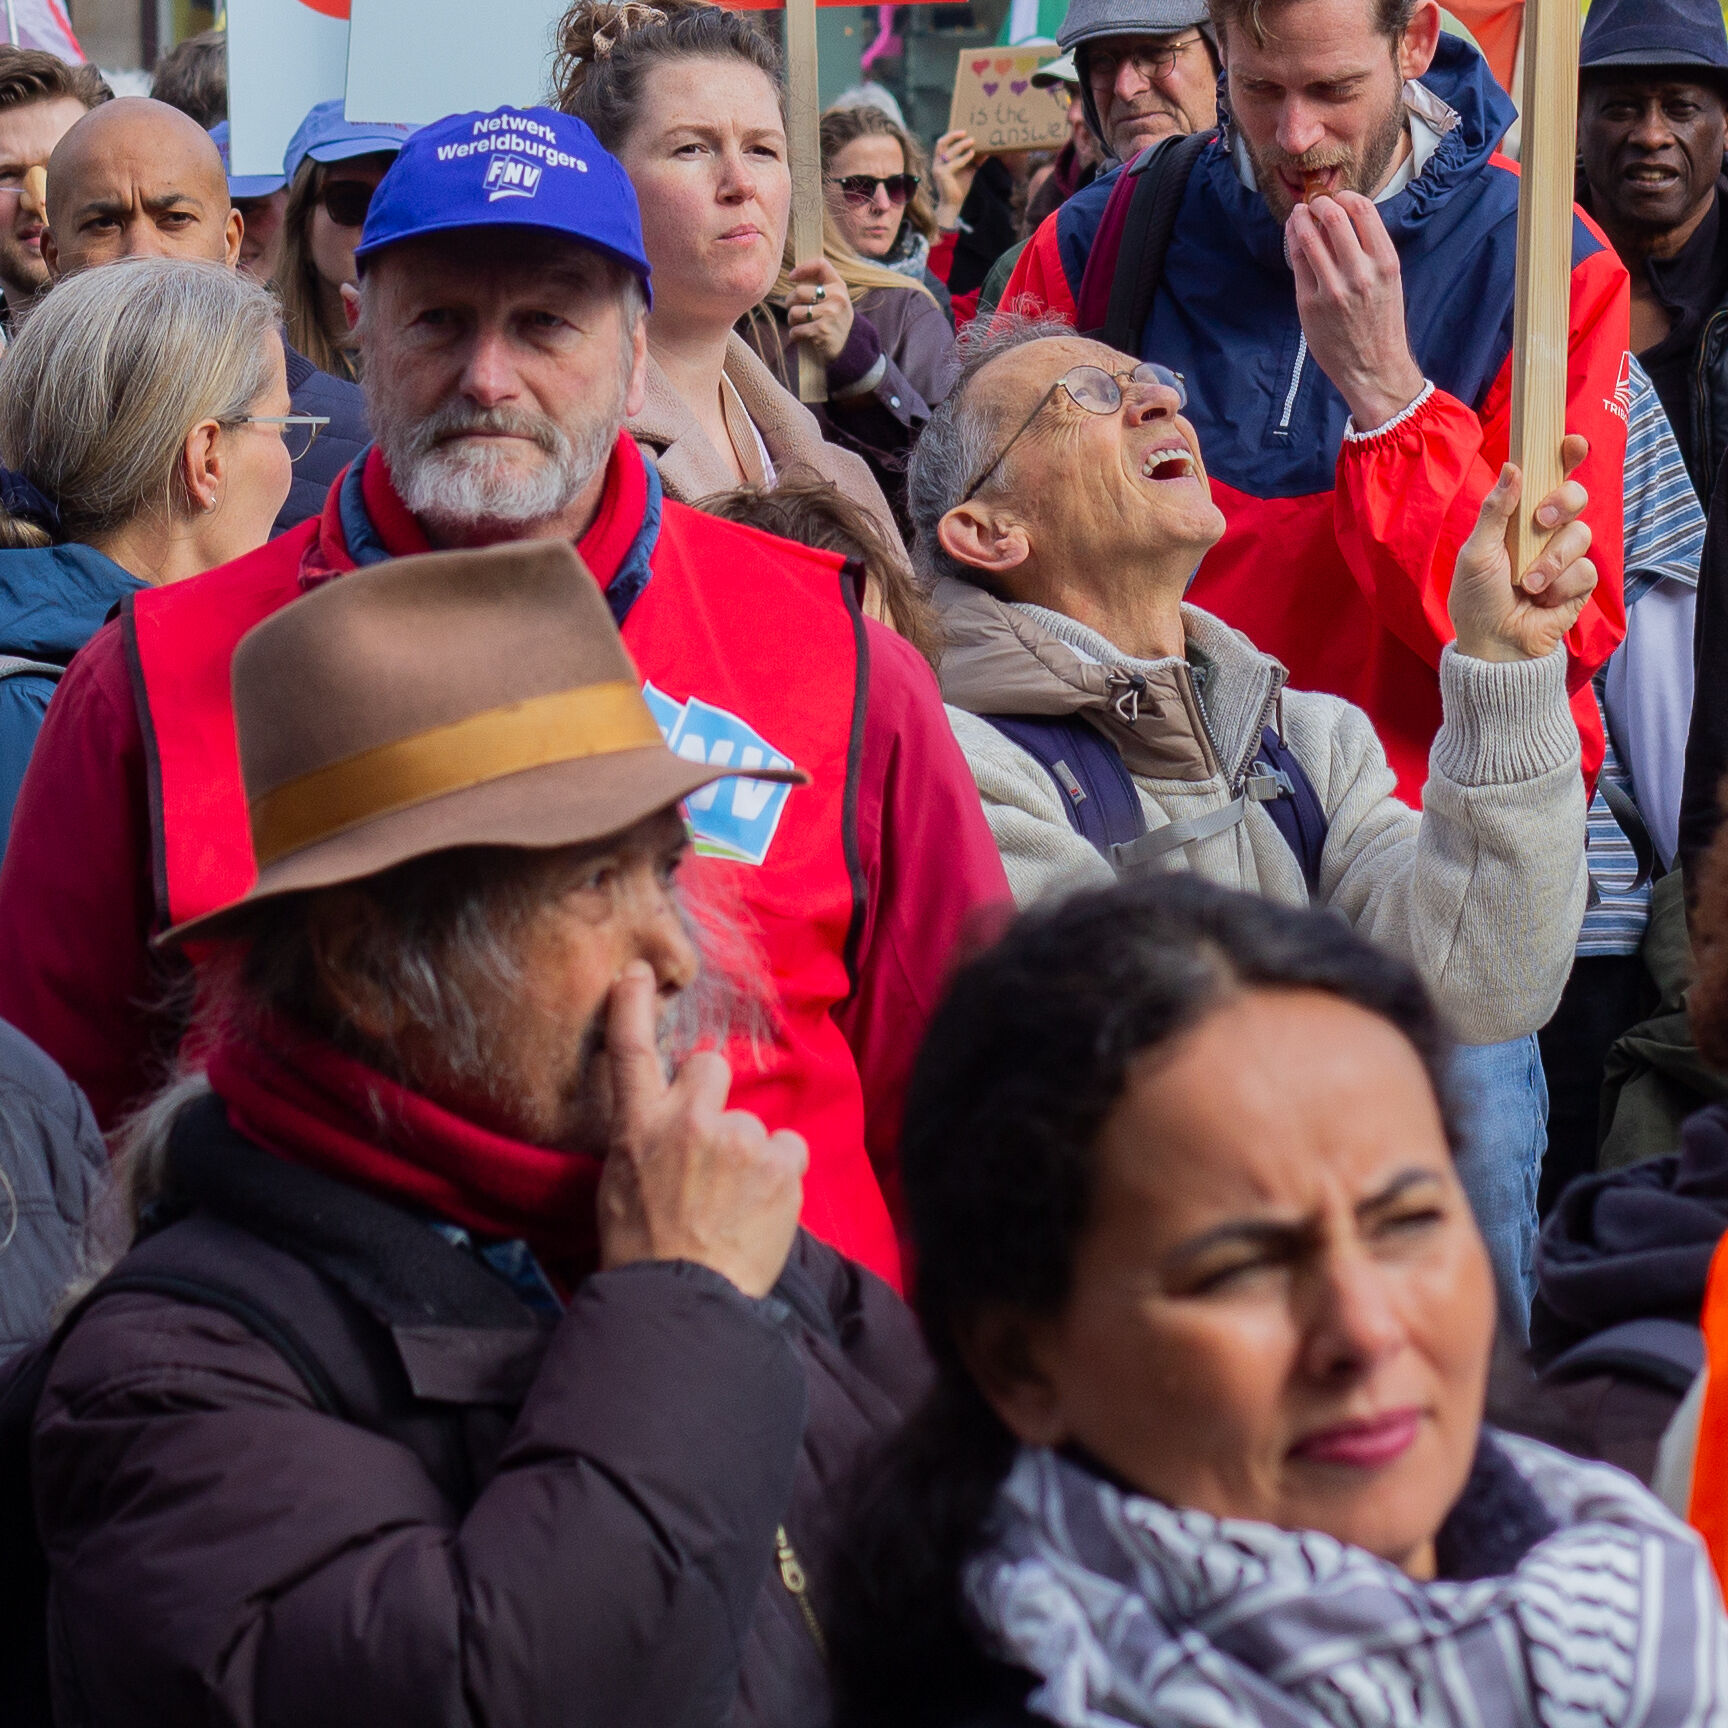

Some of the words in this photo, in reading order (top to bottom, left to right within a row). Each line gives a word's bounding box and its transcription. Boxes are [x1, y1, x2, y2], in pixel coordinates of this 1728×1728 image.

[970, 106, 988, 125] is
[997, 104, 1030, 124] the
[473, 114, 557, 145] Netwerk
[437, 134, 588, 173] Wereldburgers
[487, 161, 540, 187] FNV
[1602, 398, 1629, 426] TRIB
[660, 725, 791, 822] NV
